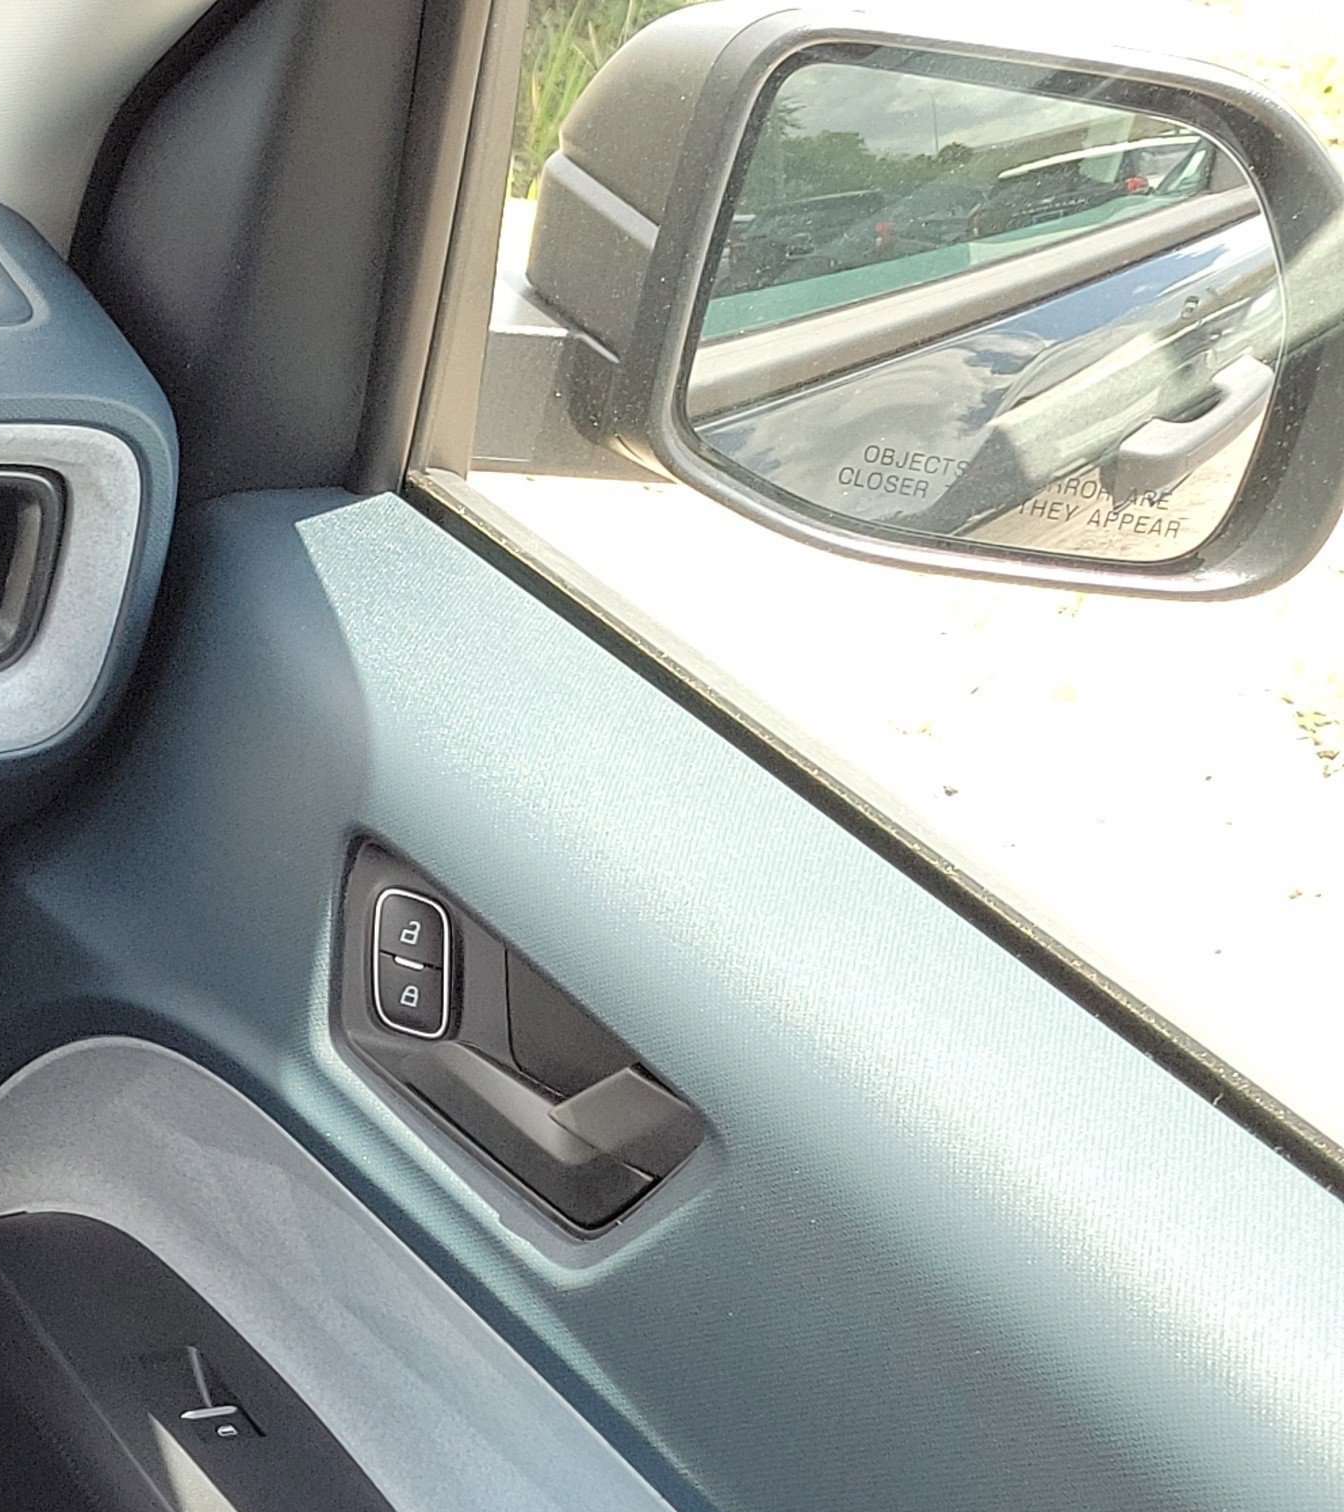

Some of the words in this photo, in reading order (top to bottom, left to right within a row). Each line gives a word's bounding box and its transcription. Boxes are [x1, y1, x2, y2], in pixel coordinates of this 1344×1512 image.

[863, 444, 971, 478] OBJECTS
[837, 466, 930, 499] CLOSER
[1086, 508, 1181, 538] APPEAR
